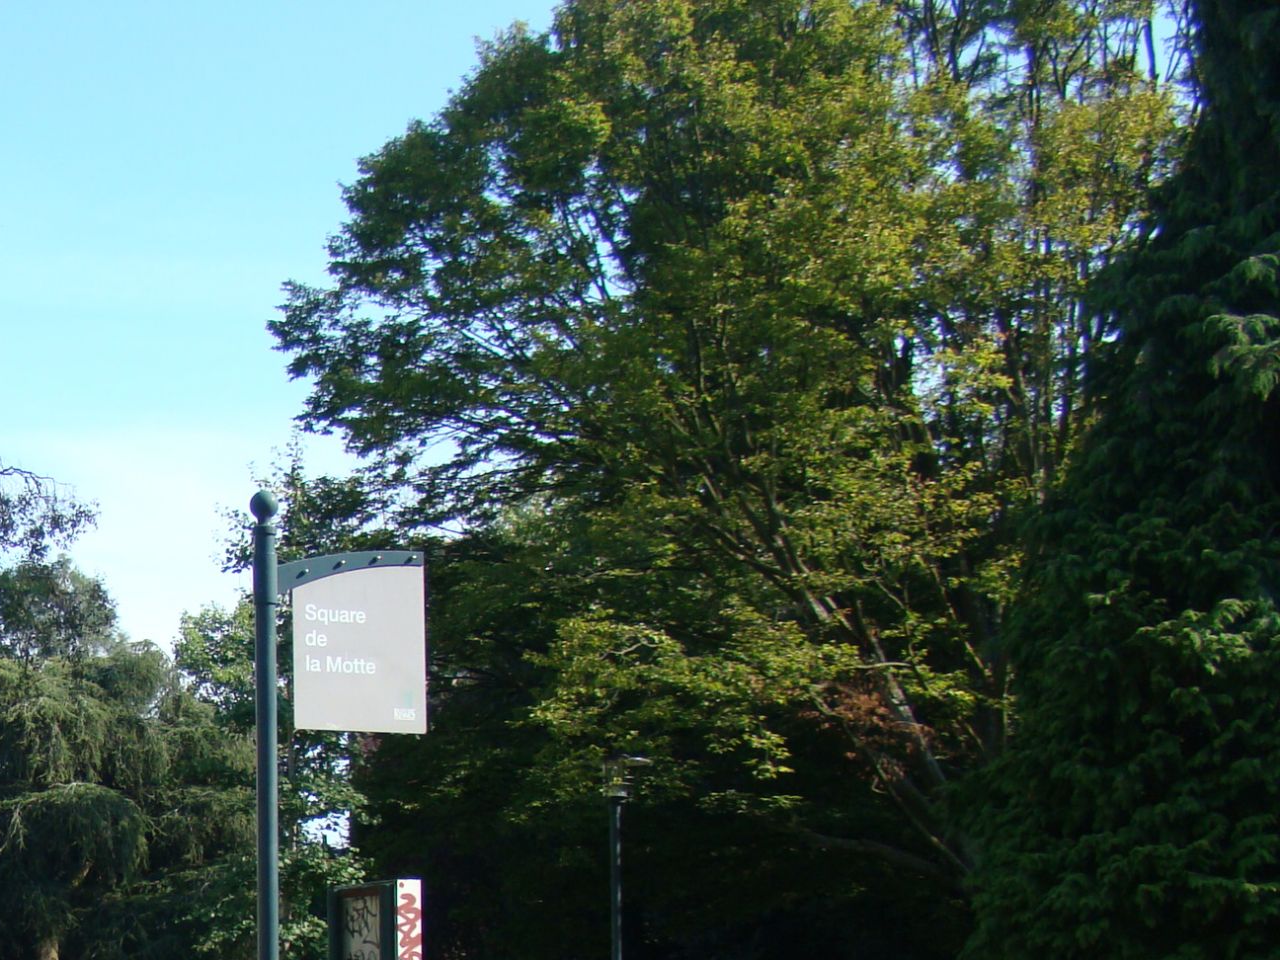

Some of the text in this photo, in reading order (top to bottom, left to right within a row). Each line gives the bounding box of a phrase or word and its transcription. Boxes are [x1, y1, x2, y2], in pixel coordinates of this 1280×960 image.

[305, 604, 366, 625] Square
[305, 630, 327, 647] de
[305, 655, 376, 674] la Motte
